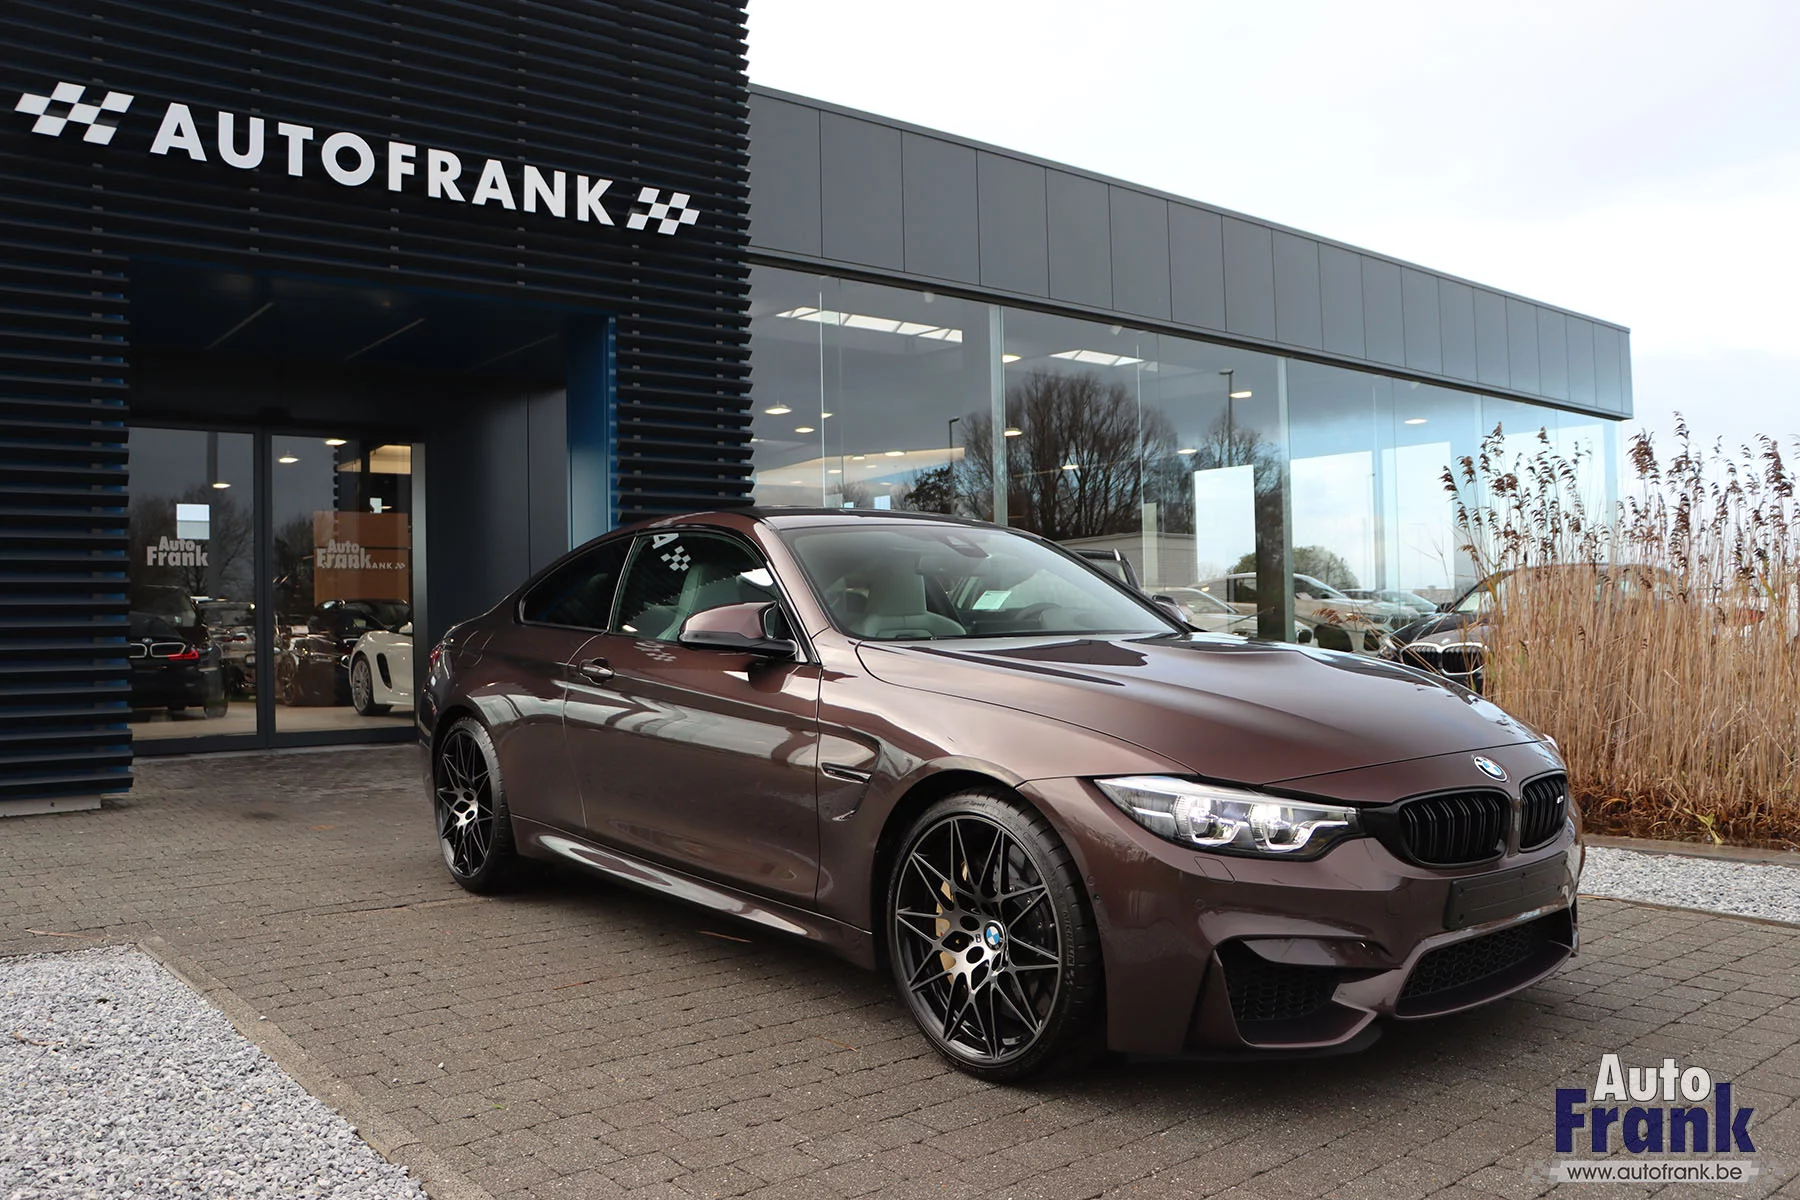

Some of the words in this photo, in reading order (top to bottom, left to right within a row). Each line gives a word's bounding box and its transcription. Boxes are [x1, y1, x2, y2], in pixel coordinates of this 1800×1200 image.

[149, 102, 616, 228] AUTOFRANK
[159, 536, 196, 551] Auto
[328, 539, 361, 553] Auto
[147, 545, 209, 567] Frank
